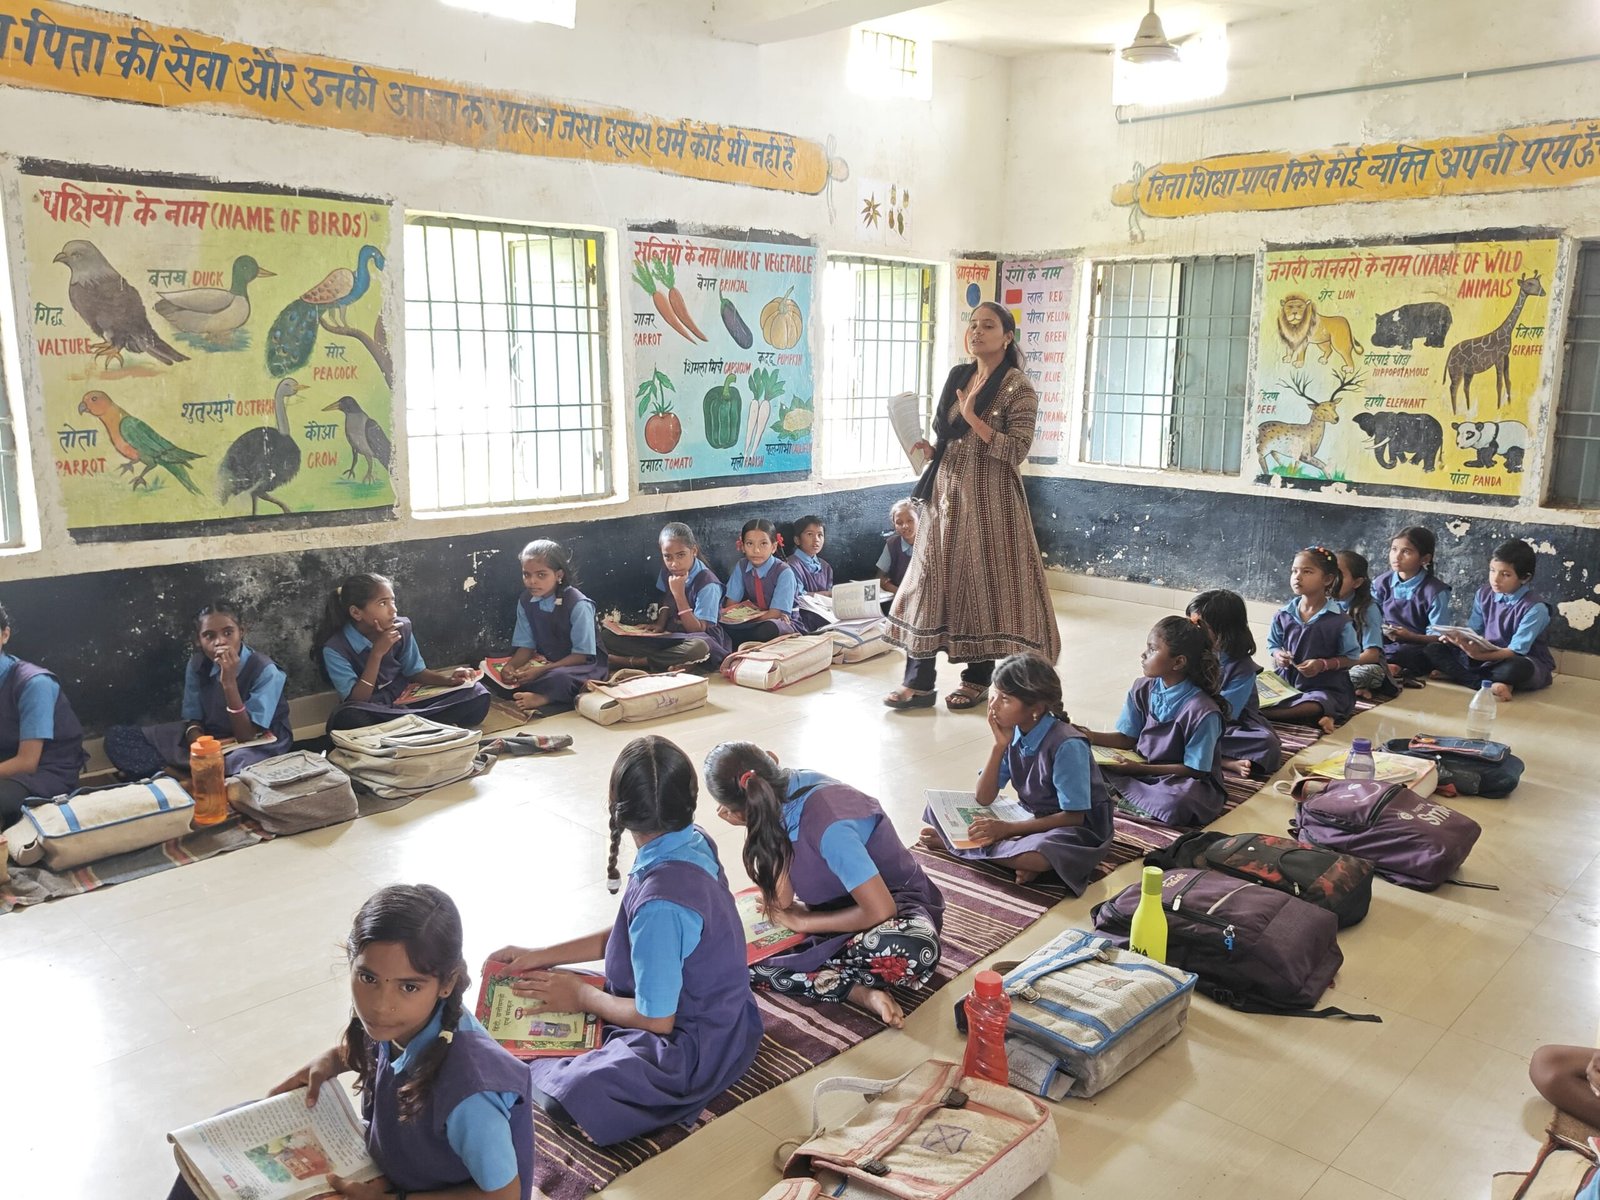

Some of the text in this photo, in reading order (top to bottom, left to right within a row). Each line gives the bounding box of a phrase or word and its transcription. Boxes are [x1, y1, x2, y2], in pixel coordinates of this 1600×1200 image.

[114, 27, 166, 82] की
[164, 34, 234, 93] सेवा
[234, 47, 305, 111] और
[302, 65, 378, 113] उनकी
[605, 117, 652, 158] दूसरा
[656, 118, 689, 160] धर्म
[690, 125, 725, 167] कोई
[727, 130, 751, 167] भी
[1146, 170, 1188, 202] बिना
[1185, 165, 1240, 200] शिक्षा
[1236, 164, 1284, 197] प्राप्त
[1281, 154, 1325, 193] किये
[1324, 148, 1367, 188] कोई
[1367, 143, 1435, 186] व्यक्ति
[1435, 133, 1520, 180] अपनी
[1521, 133, 1582, 175] परम
[133, 188, 166, 227] के
[164, 199, 210, 230] नाम
[211, 202, 275, 234] (NAME
[280, 208, 301, 233] OF
[308, 210, 368, 238] BIRDS)
[684, 239, 699, 265] के
[698, 246, 720, 267] नाम
[720, 249, 748, 270] (NAME
[750, 251, 761, 270] OF
[1027, 264, 1040, 281] के
[1041, 266, 1064, 279] नाम
[1267, 250, 1523, 283] जंगली जानवरों के नाम (NAME OF WILD
[192, 270, 224, 286] DUCK
[720, 278, 748, 293] BRINJAL
[1338, 289, 1355, 300] LION
[1457, 278, 1514, 299] ANIMALS
[1027, 291, 1063, 305] लाल RED
[634, 312, 657, 329] गाजर
[1046, 311, 1070, 322] YELLOW
[1045, 331, 1067, 342] GREEN
[38, 337, 92, 355] VALTURE
[324, 342, 348, 362] मोर
[1511, 344, 1543, 356] GIRAFFE
[313, 365, 358, 381] PEACOCK
[684, 357, 707, 377] शिमला
[1045, 371, 1061, 382] BLUE
[1257, 404, 1276, 414] DEER
[1386, 397, 1427, 408] ELEPHANT
[57, 423, 98, 453] तोता
[55, 458, 106, 477] PARROT
[307, 452, 338, 469] CROW
[640, 456, 693, 473] टमाटर TOMATO
[1472, 475, 1502, 487] PANDA
